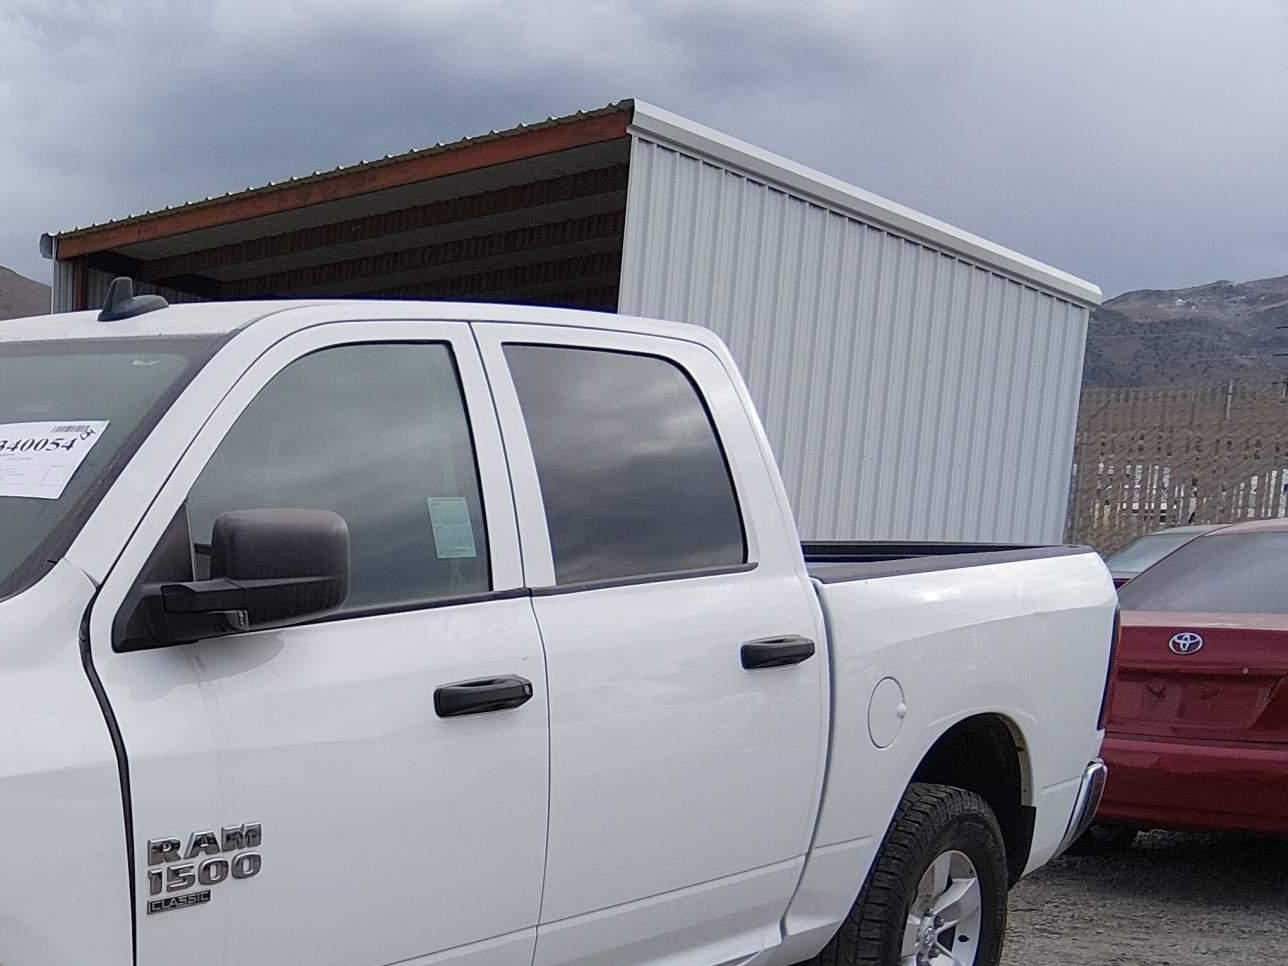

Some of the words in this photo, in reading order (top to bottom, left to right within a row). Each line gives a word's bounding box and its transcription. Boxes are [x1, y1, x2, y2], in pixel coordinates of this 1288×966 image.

[147, 821, 262, 866] RAM
[147, 851, 262, 896] 1500
[147, 889, 211, 915] CLASSIC
